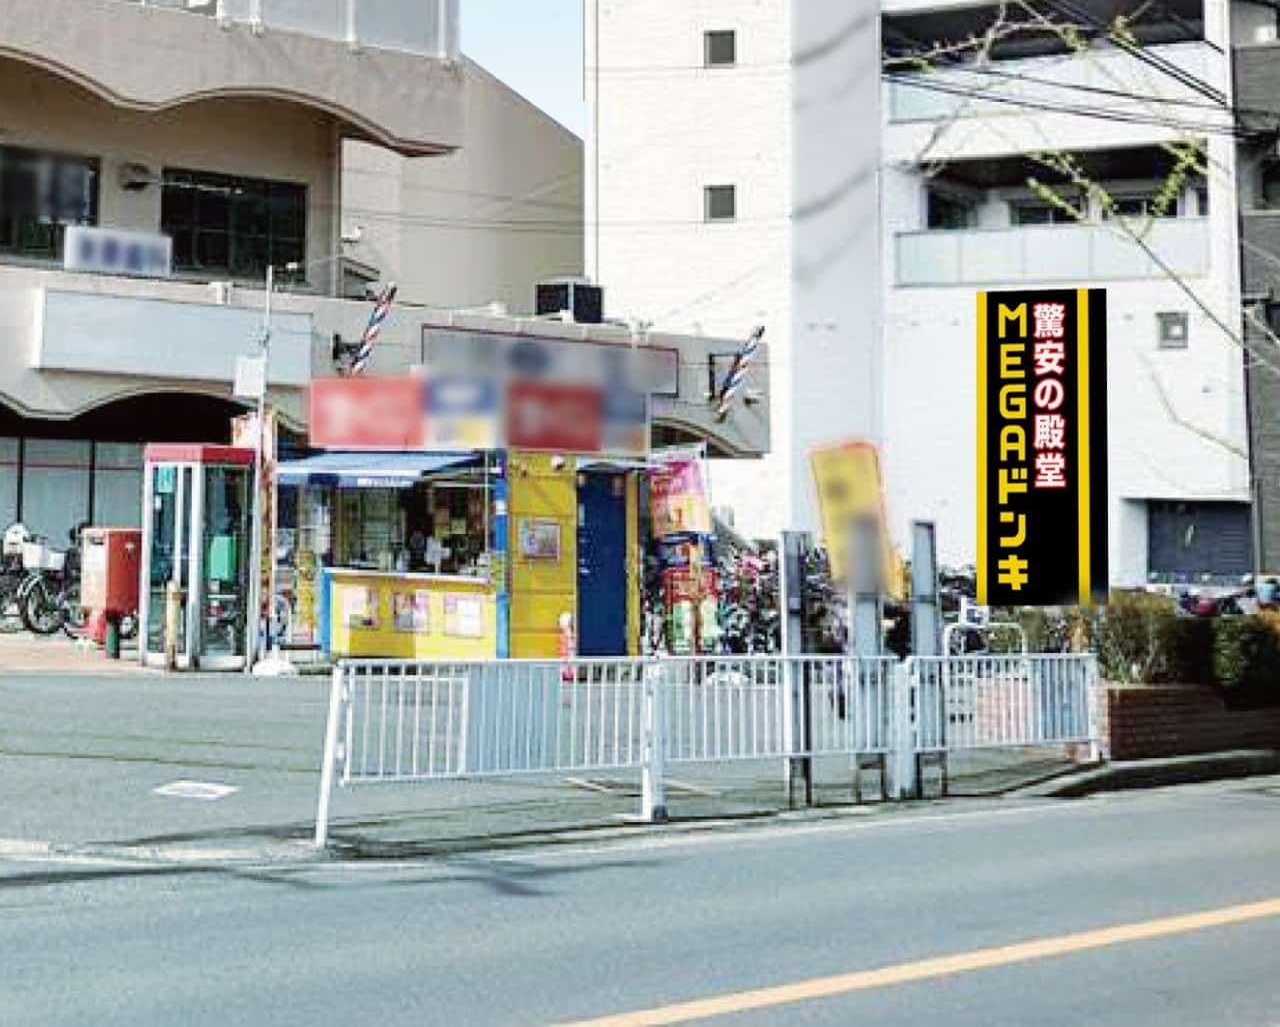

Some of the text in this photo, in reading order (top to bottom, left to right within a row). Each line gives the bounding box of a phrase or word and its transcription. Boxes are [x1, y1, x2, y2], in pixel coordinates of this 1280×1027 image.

[997, 302, 1028, 591] MEGAドンキ
[1033, 303, 1066, 488] 驚安の殿堂
